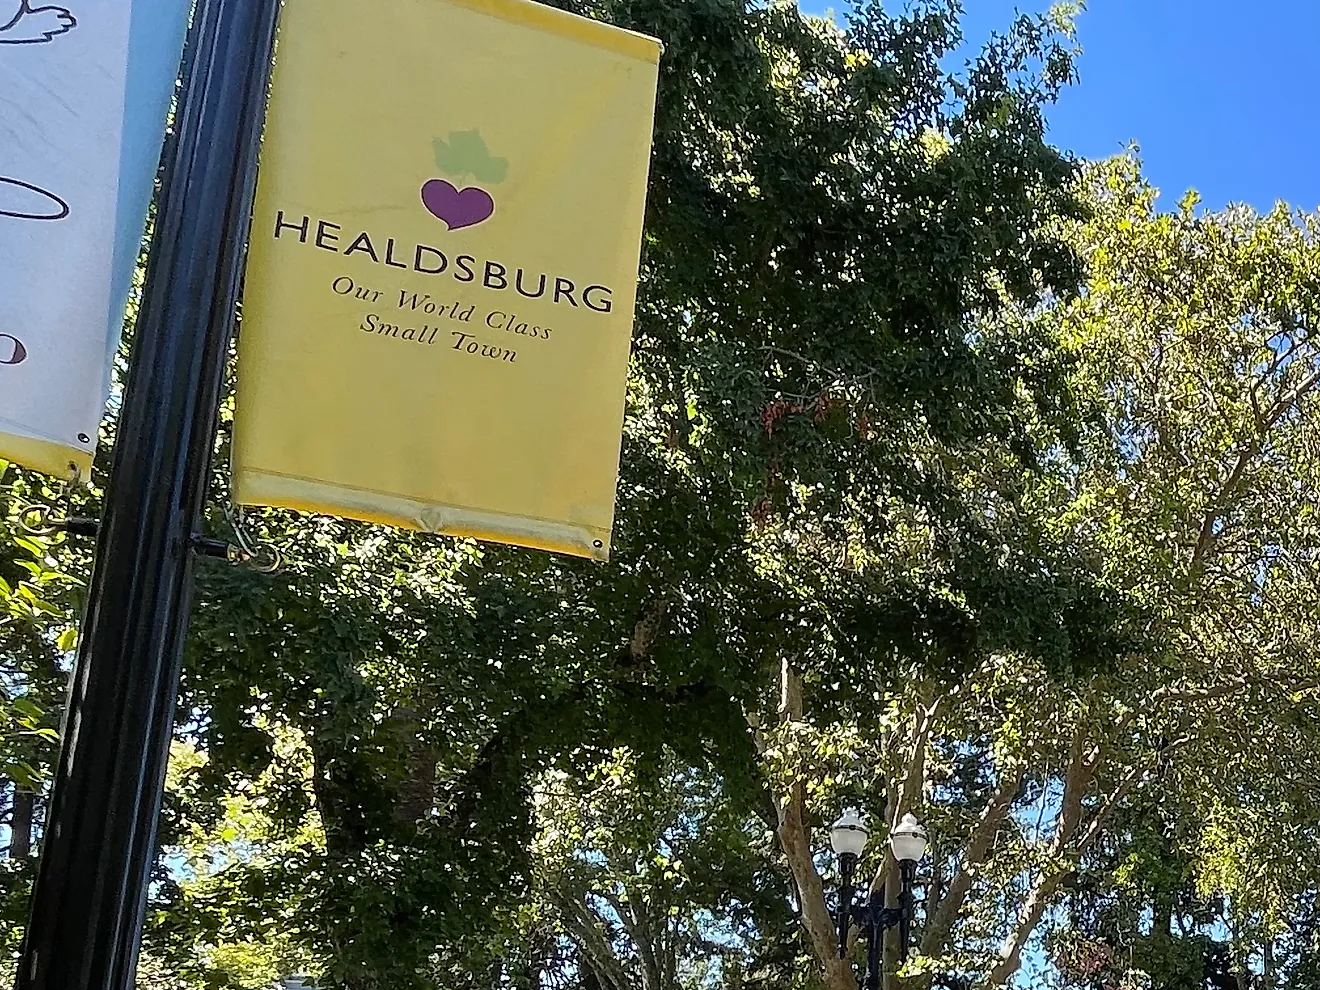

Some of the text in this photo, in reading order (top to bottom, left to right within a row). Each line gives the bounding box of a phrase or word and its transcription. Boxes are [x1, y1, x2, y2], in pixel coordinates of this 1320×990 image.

[273, 210, 614, 313] HEALDSBURG
[332, 276, 553, 340] Our World Class
[360, 313, 517, 363] Small Town
